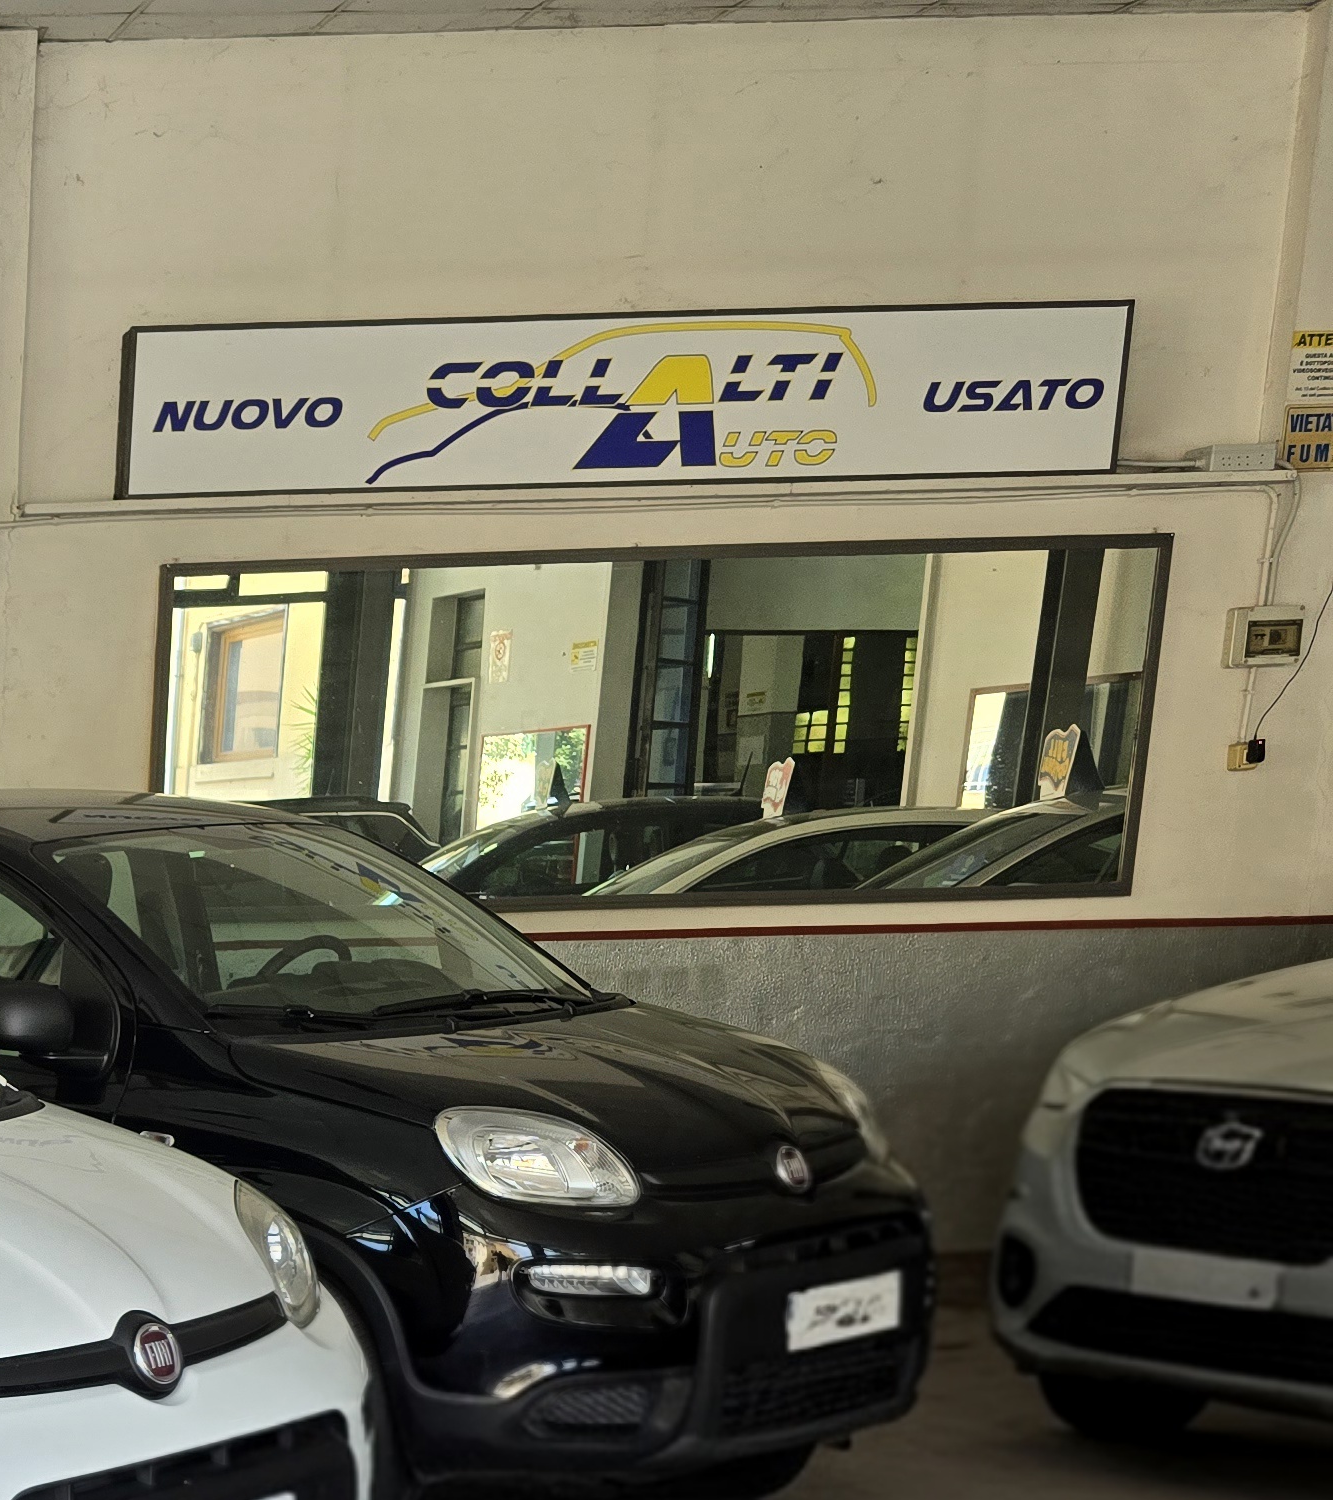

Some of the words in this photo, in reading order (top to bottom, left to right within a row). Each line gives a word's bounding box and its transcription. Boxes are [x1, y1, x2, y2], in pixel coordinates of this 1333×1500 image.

[922, 377, 1105, 413] USATO
[152, 396, 343, 433] NUOVO
[1290, 413, 1333, 433] VIETA
